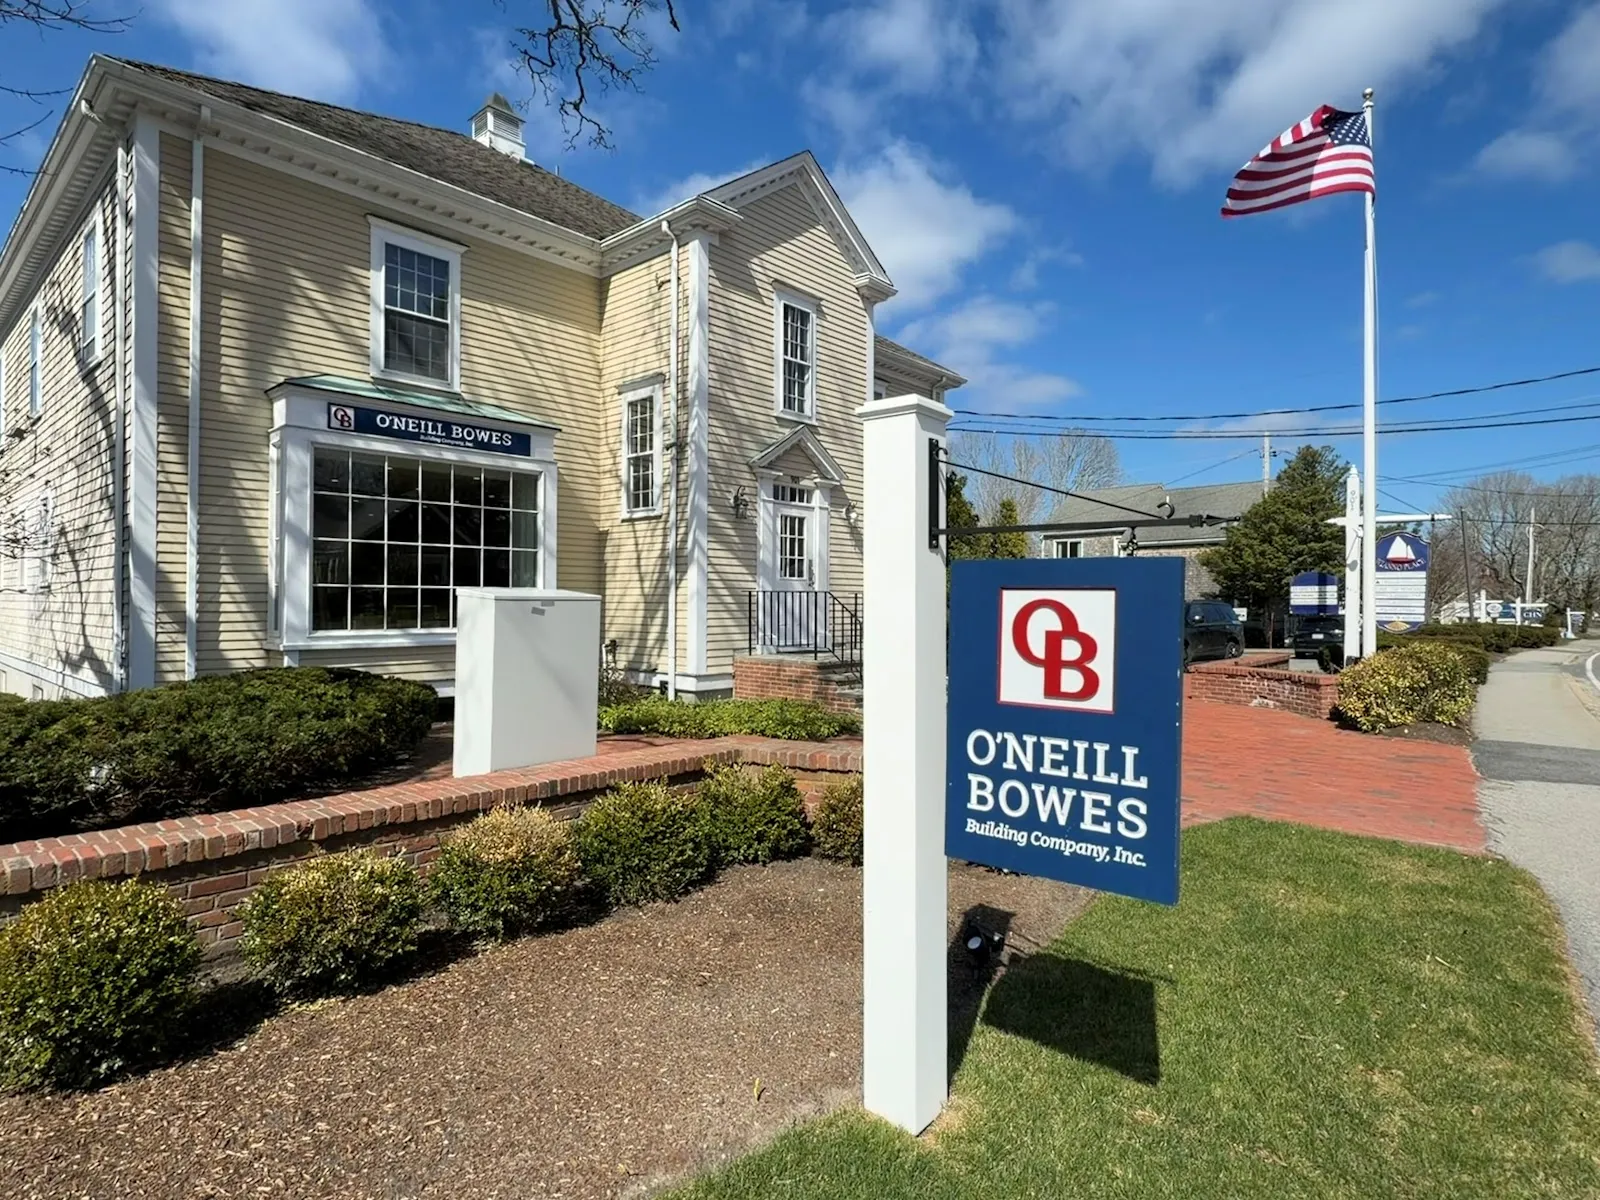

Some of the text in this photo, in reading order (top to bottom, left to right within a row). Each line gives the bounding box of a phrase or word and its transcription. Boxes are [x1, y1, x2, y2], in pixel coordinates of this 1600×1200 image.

[377, 414, 512, 446] O'NEILL BOWES
[966, 728, 1148, 789] O'NEILL
[966, 773, 1148, 839] BOWES
[965, 818, 1147, 867] Building Company, Inc.
